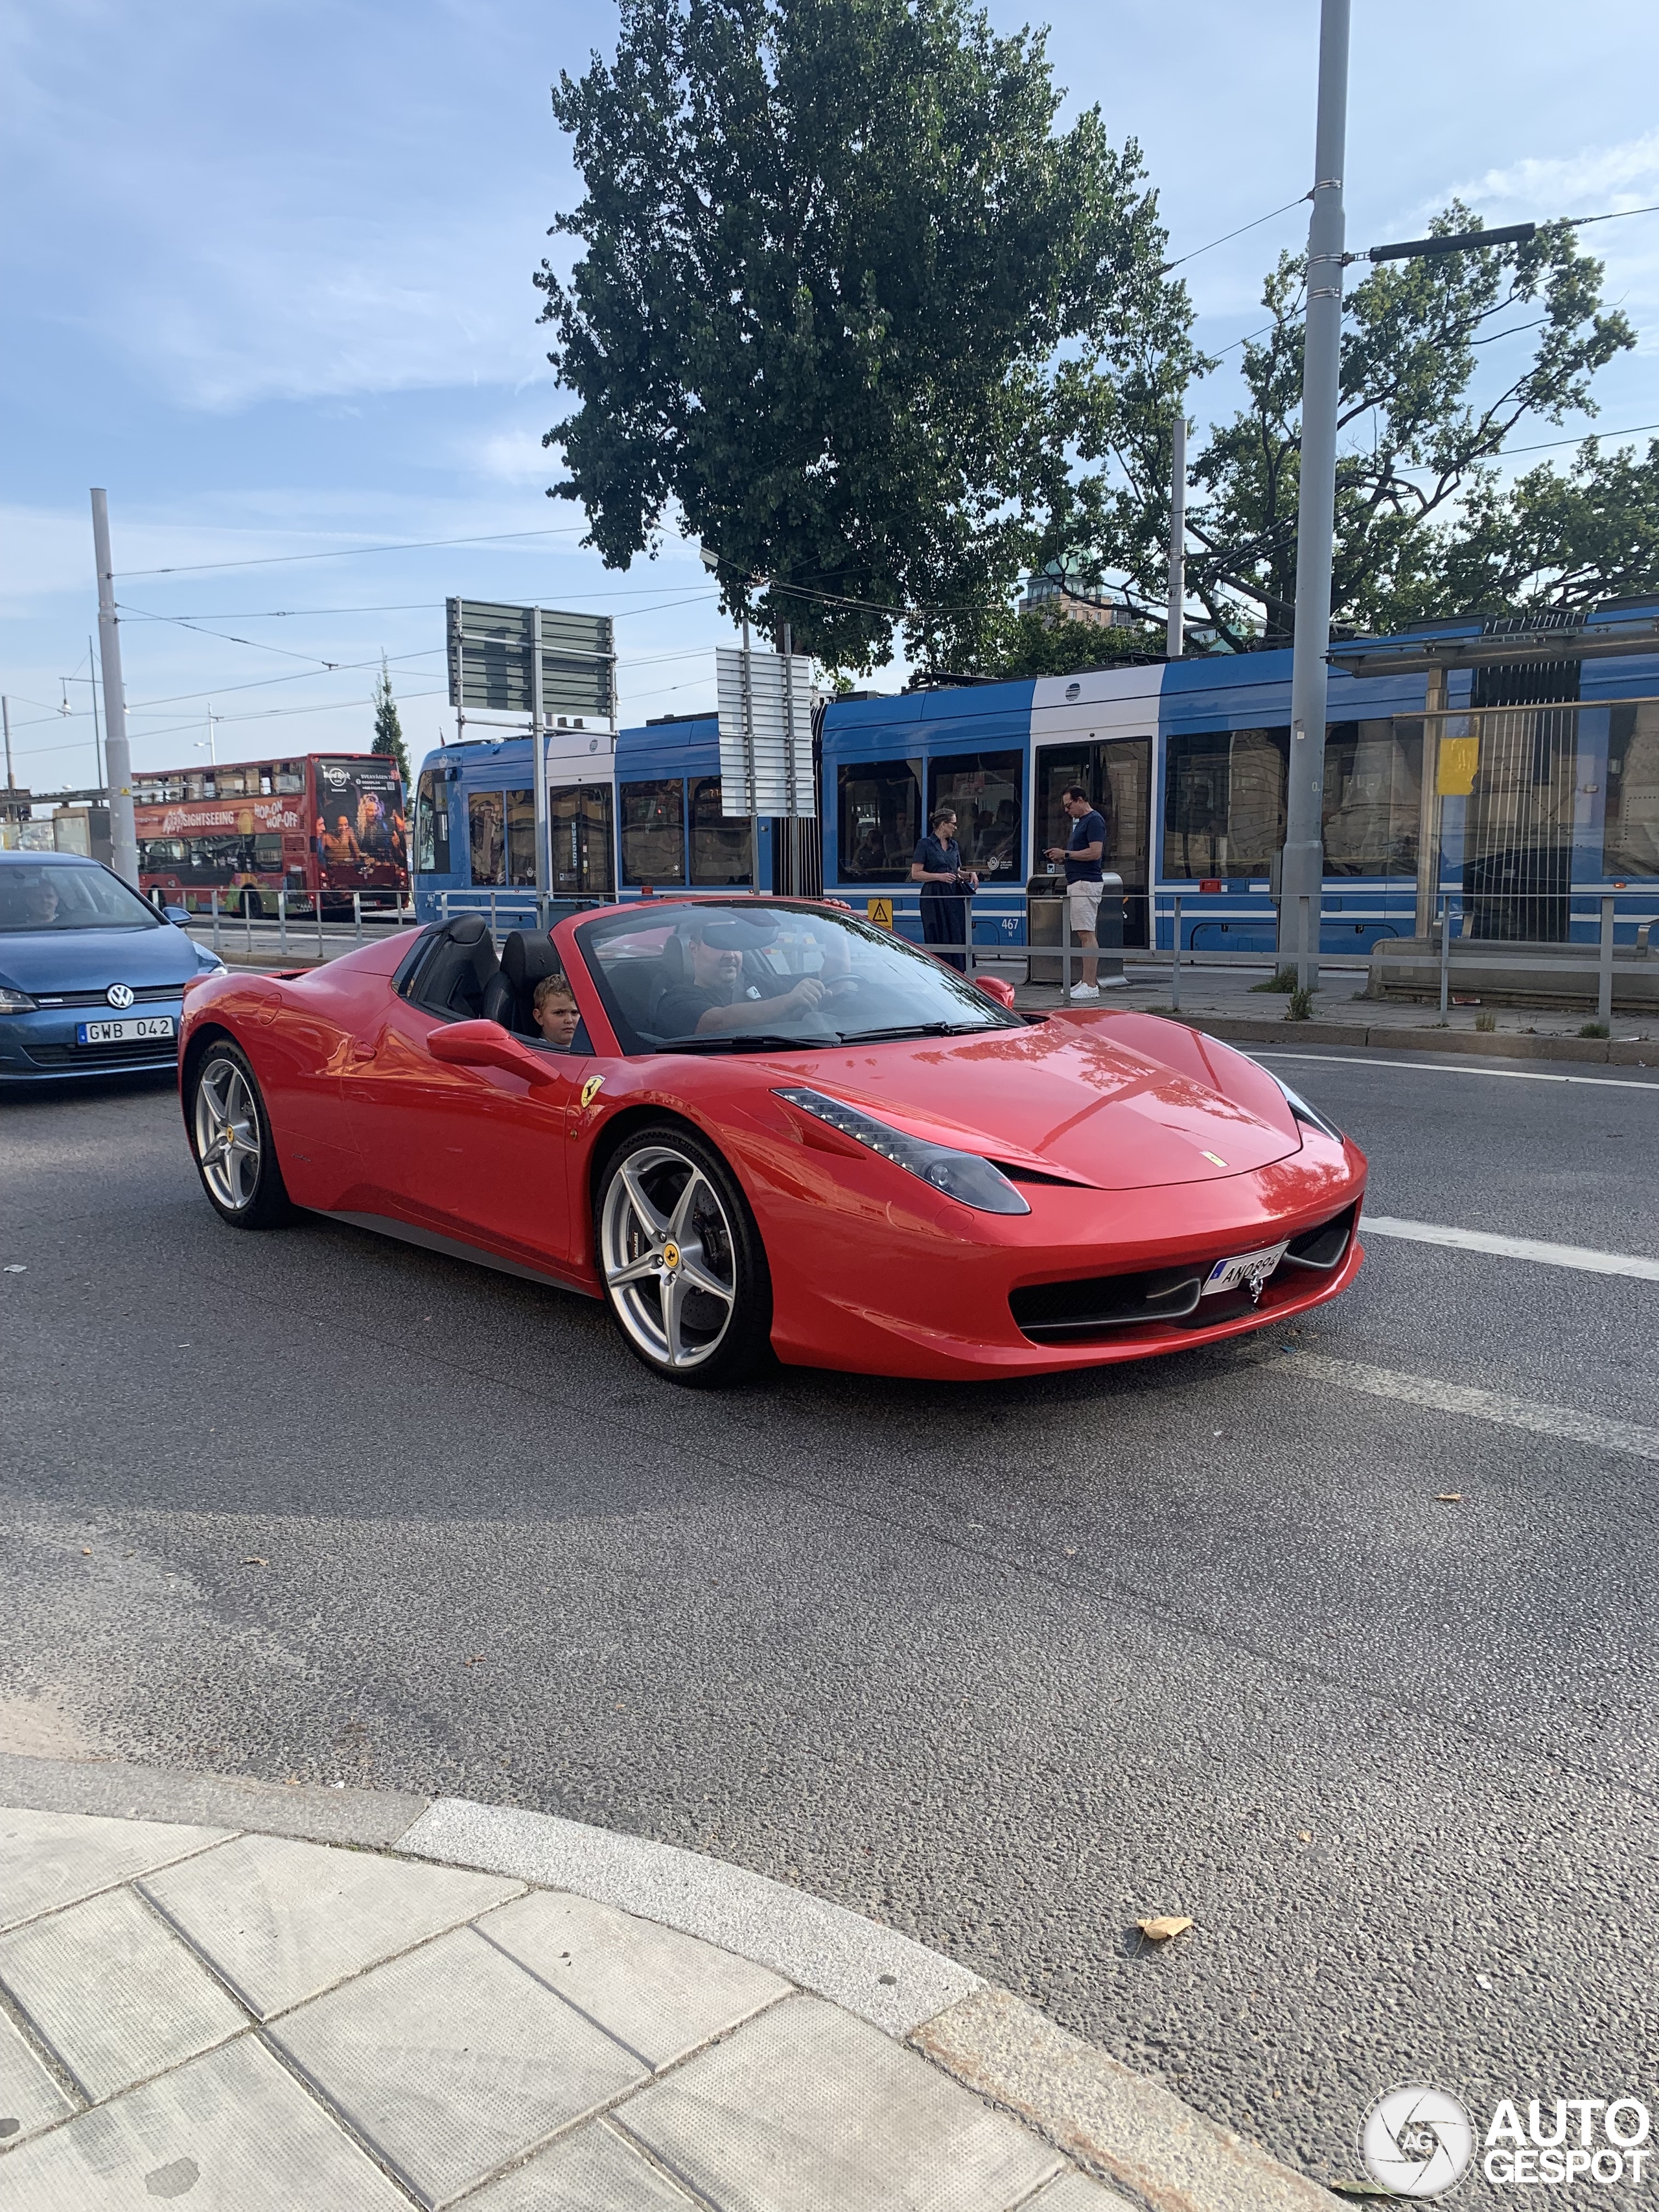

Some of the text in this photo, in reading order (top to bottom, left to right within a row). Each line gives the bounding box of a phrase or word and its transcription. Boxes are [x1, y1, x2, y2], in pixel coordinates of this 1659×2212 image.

[183, 811, 234, 826] SIGHTSEEING
[254, 800, 283, 819] HOP-ON
[266, 810, 298, 828] HOP-OFF
[1001, 918, 1019, 929] 467
[89, 1019, 170, 1040] GWB 042
